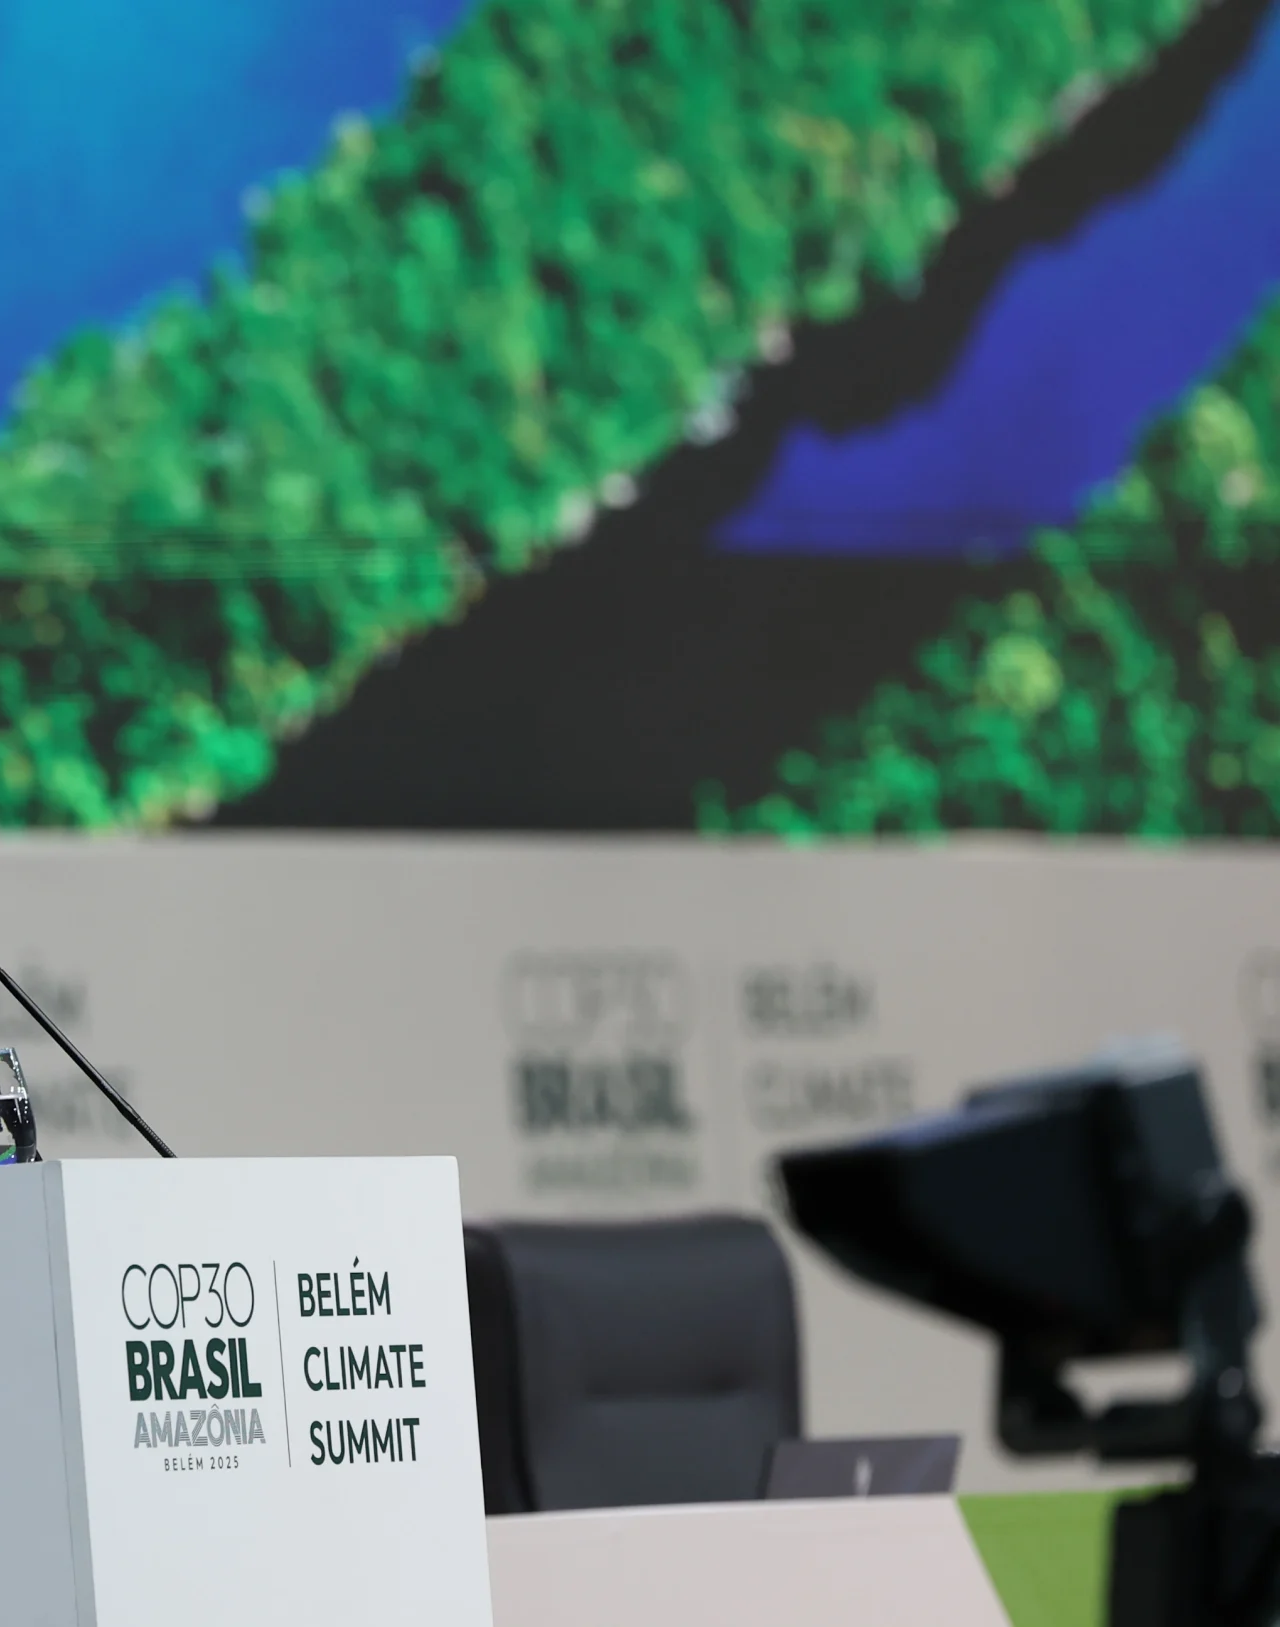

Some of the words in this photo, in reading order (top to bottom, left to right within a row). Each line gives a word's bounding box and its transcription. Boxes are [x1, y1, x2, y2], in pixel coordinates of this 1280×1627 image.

[121, 1261, 255, 1331] COP30
[297, 1256, 392, 1317] BELÉM
[125, 1337, 263, 1402] BRASIL
[303, 1344, 427, 1392] CLIMATE
[133, 1403, 267, 1449] AMAZÔNIA
[309, 1417, 421, 1466] SUMMIT
[164, 1453, 204, 1472] BELÉM
[210, 1455, 240, 1470] 2025
